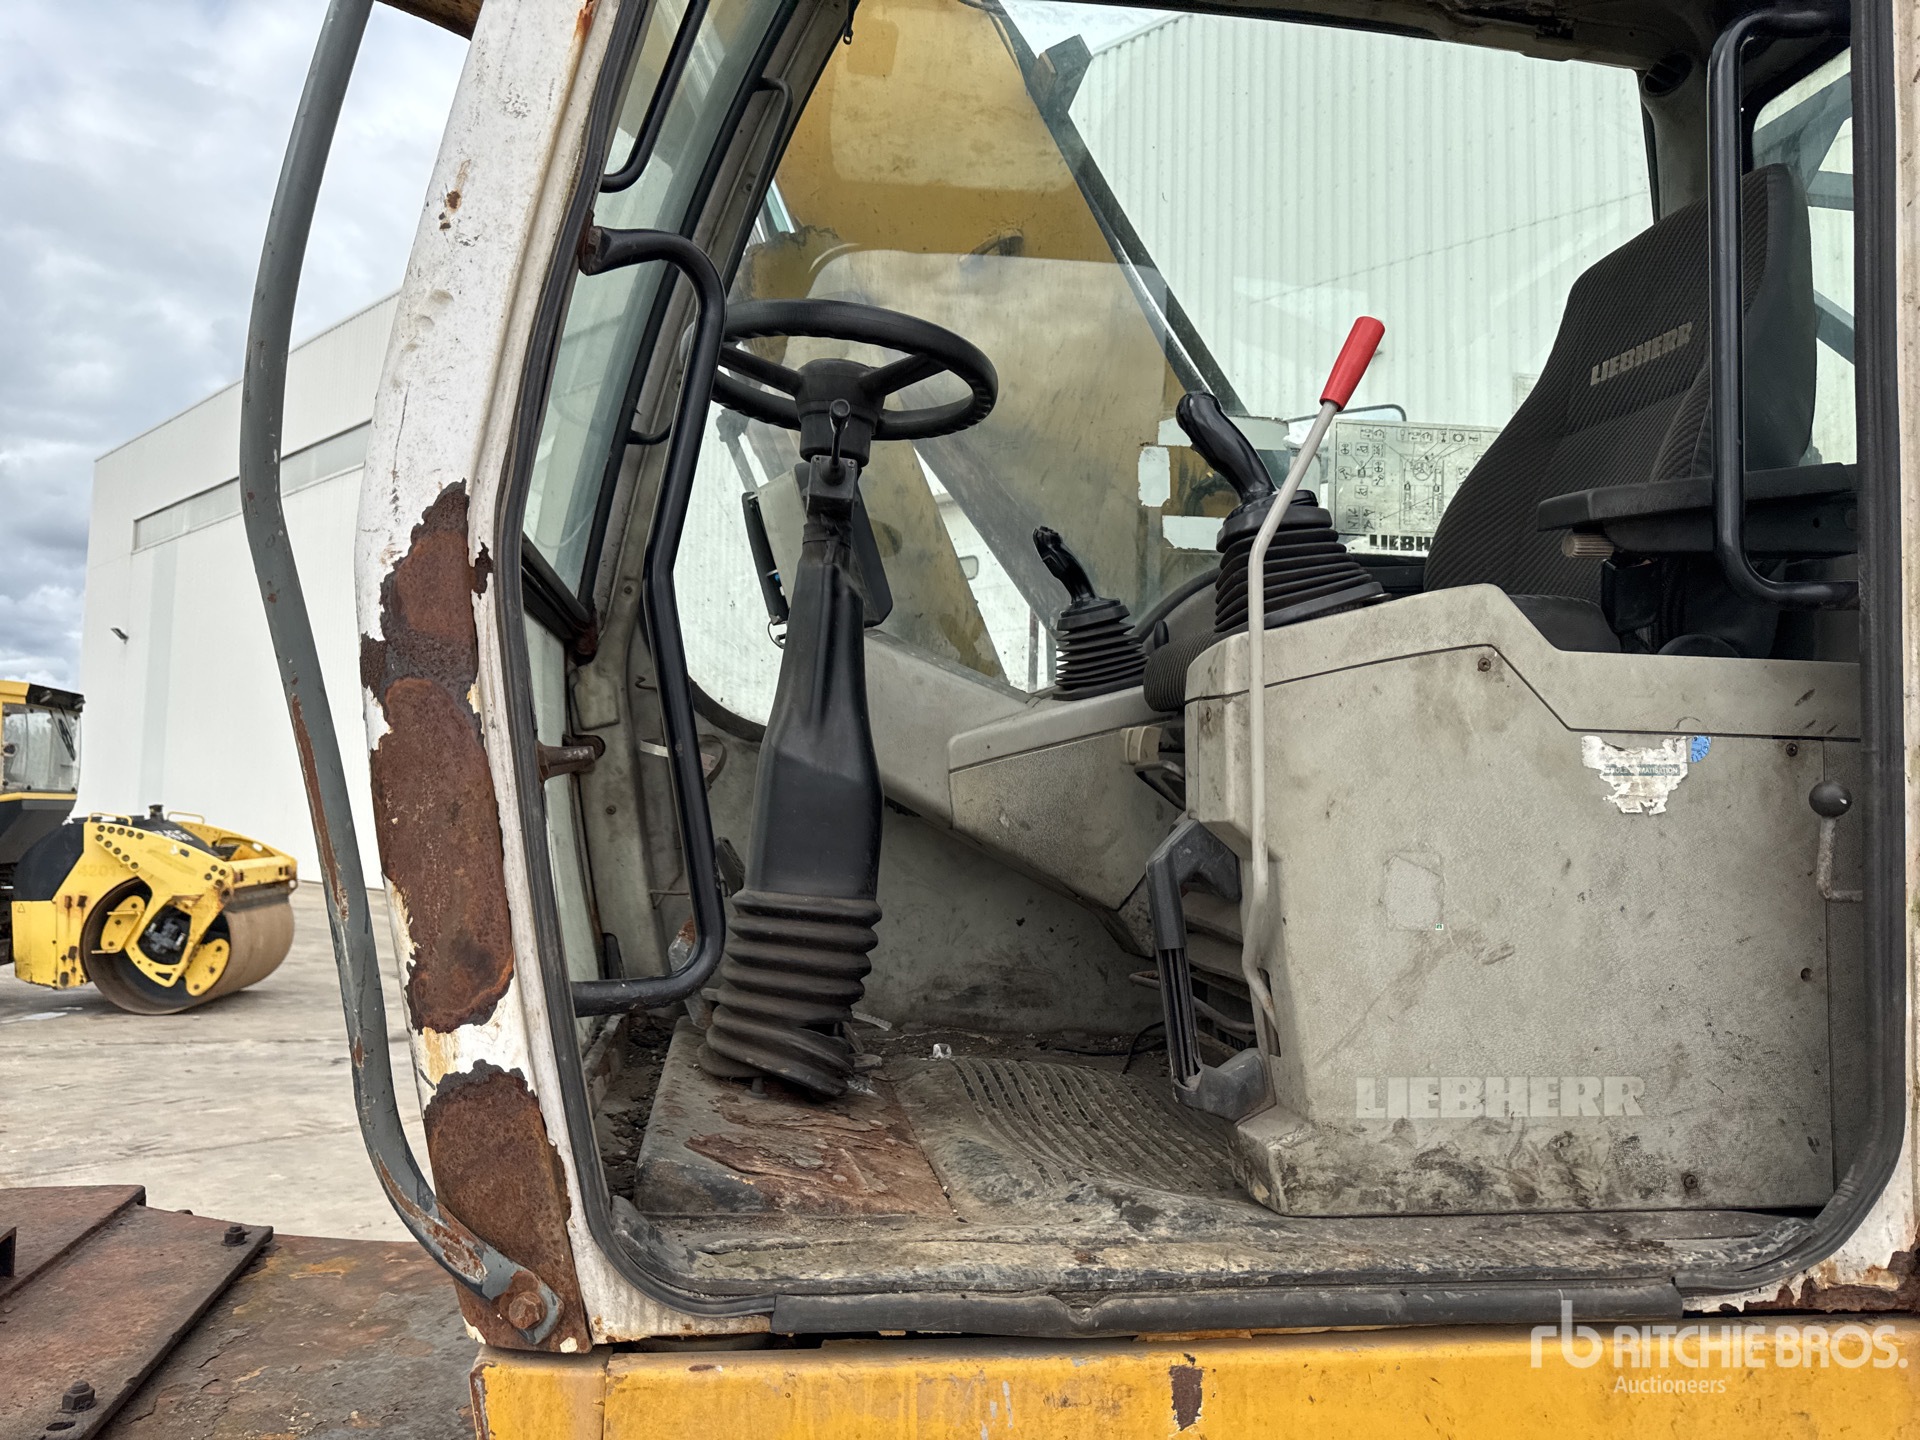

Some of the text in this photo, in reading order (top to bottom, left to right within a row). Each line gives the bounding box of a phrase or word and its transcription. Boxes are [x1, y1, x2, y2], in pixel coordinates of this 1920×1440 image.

[1590, 321, 1693, 386] LIEBHERR
[1369, 534, 1434, 552] LIEBH
[1356, 1076, 1646, 1119] LIEBHERR
